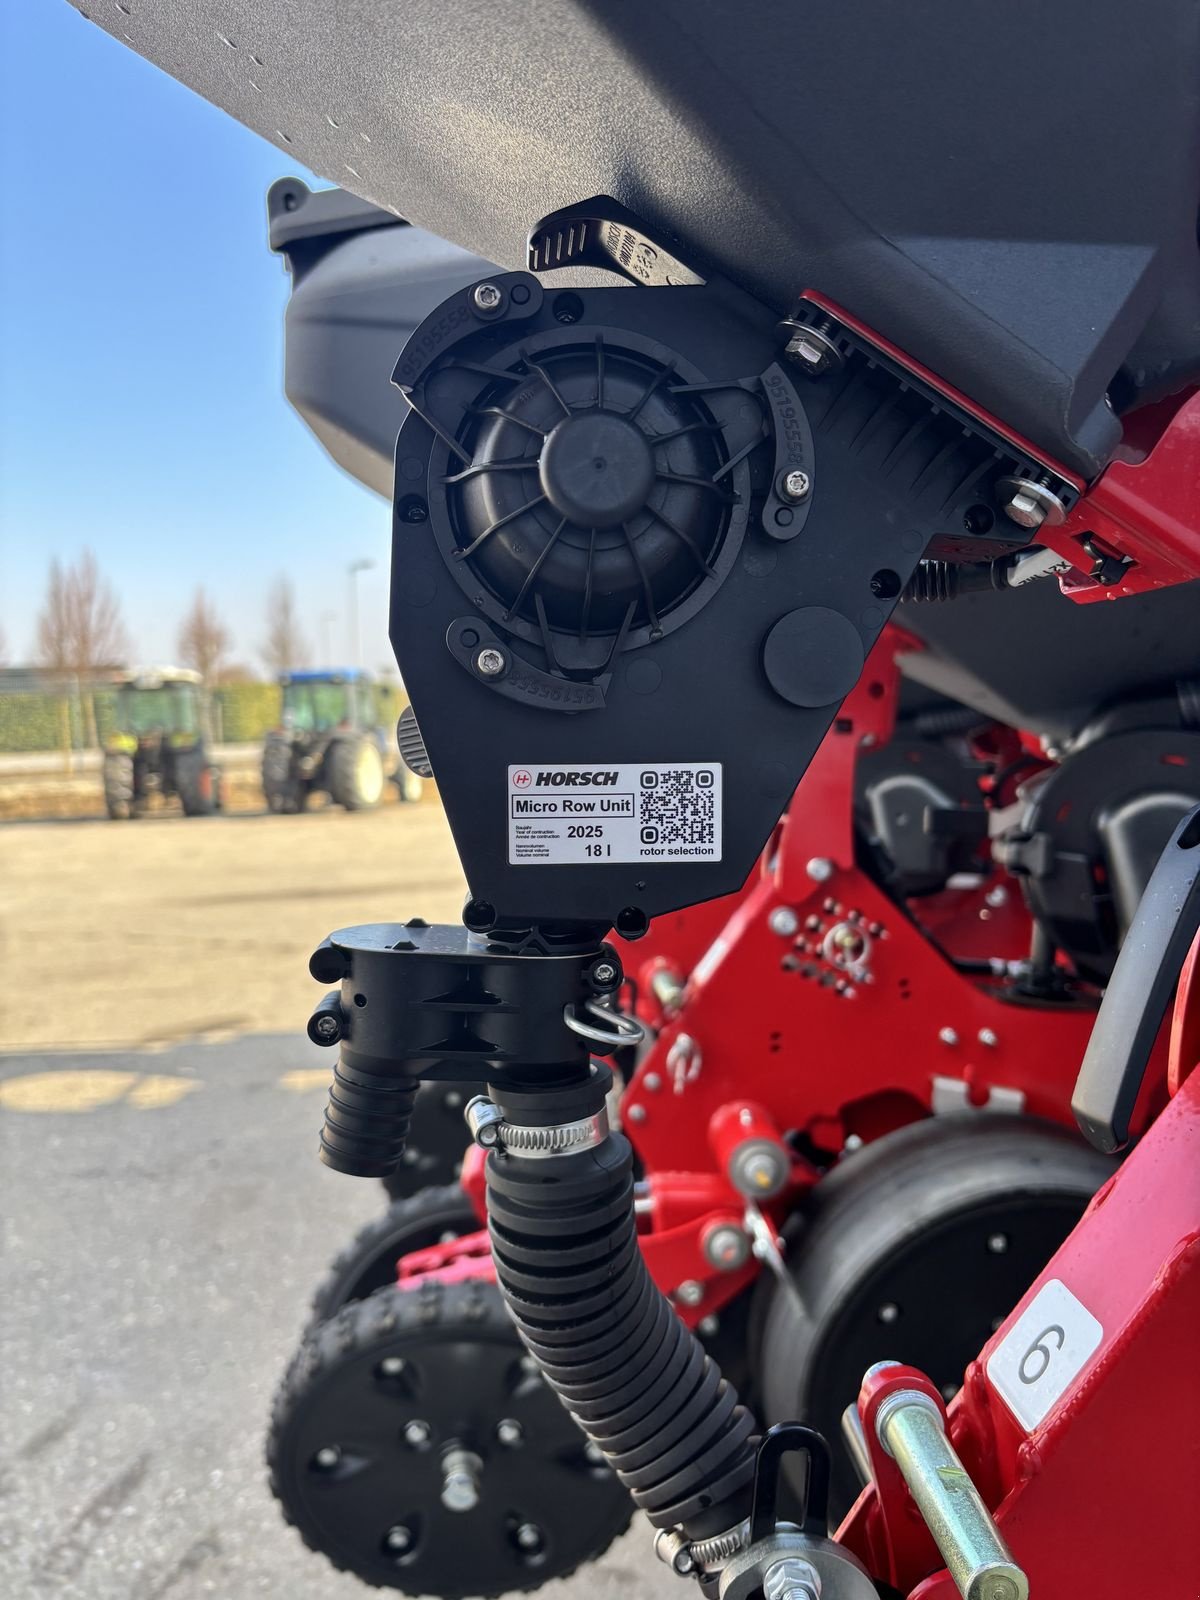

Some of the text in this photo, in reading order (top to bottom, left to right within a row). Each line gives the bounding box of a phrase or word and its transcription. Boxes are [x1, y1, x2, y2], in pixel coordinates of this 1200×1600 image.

[402, 304, 470, 378] 95195558
[765, 375, 803, 464] 95195558
[535, 771, 619, 786] HORSCH
[516, 799, 631, 813] Micro Row Unit
[567, 825, 604, 838] 2025
[584, 844, 602, 857] 18
[640, 846, 714, 855] rotor selection
[1018, 1323, 1065, 1385] 6
